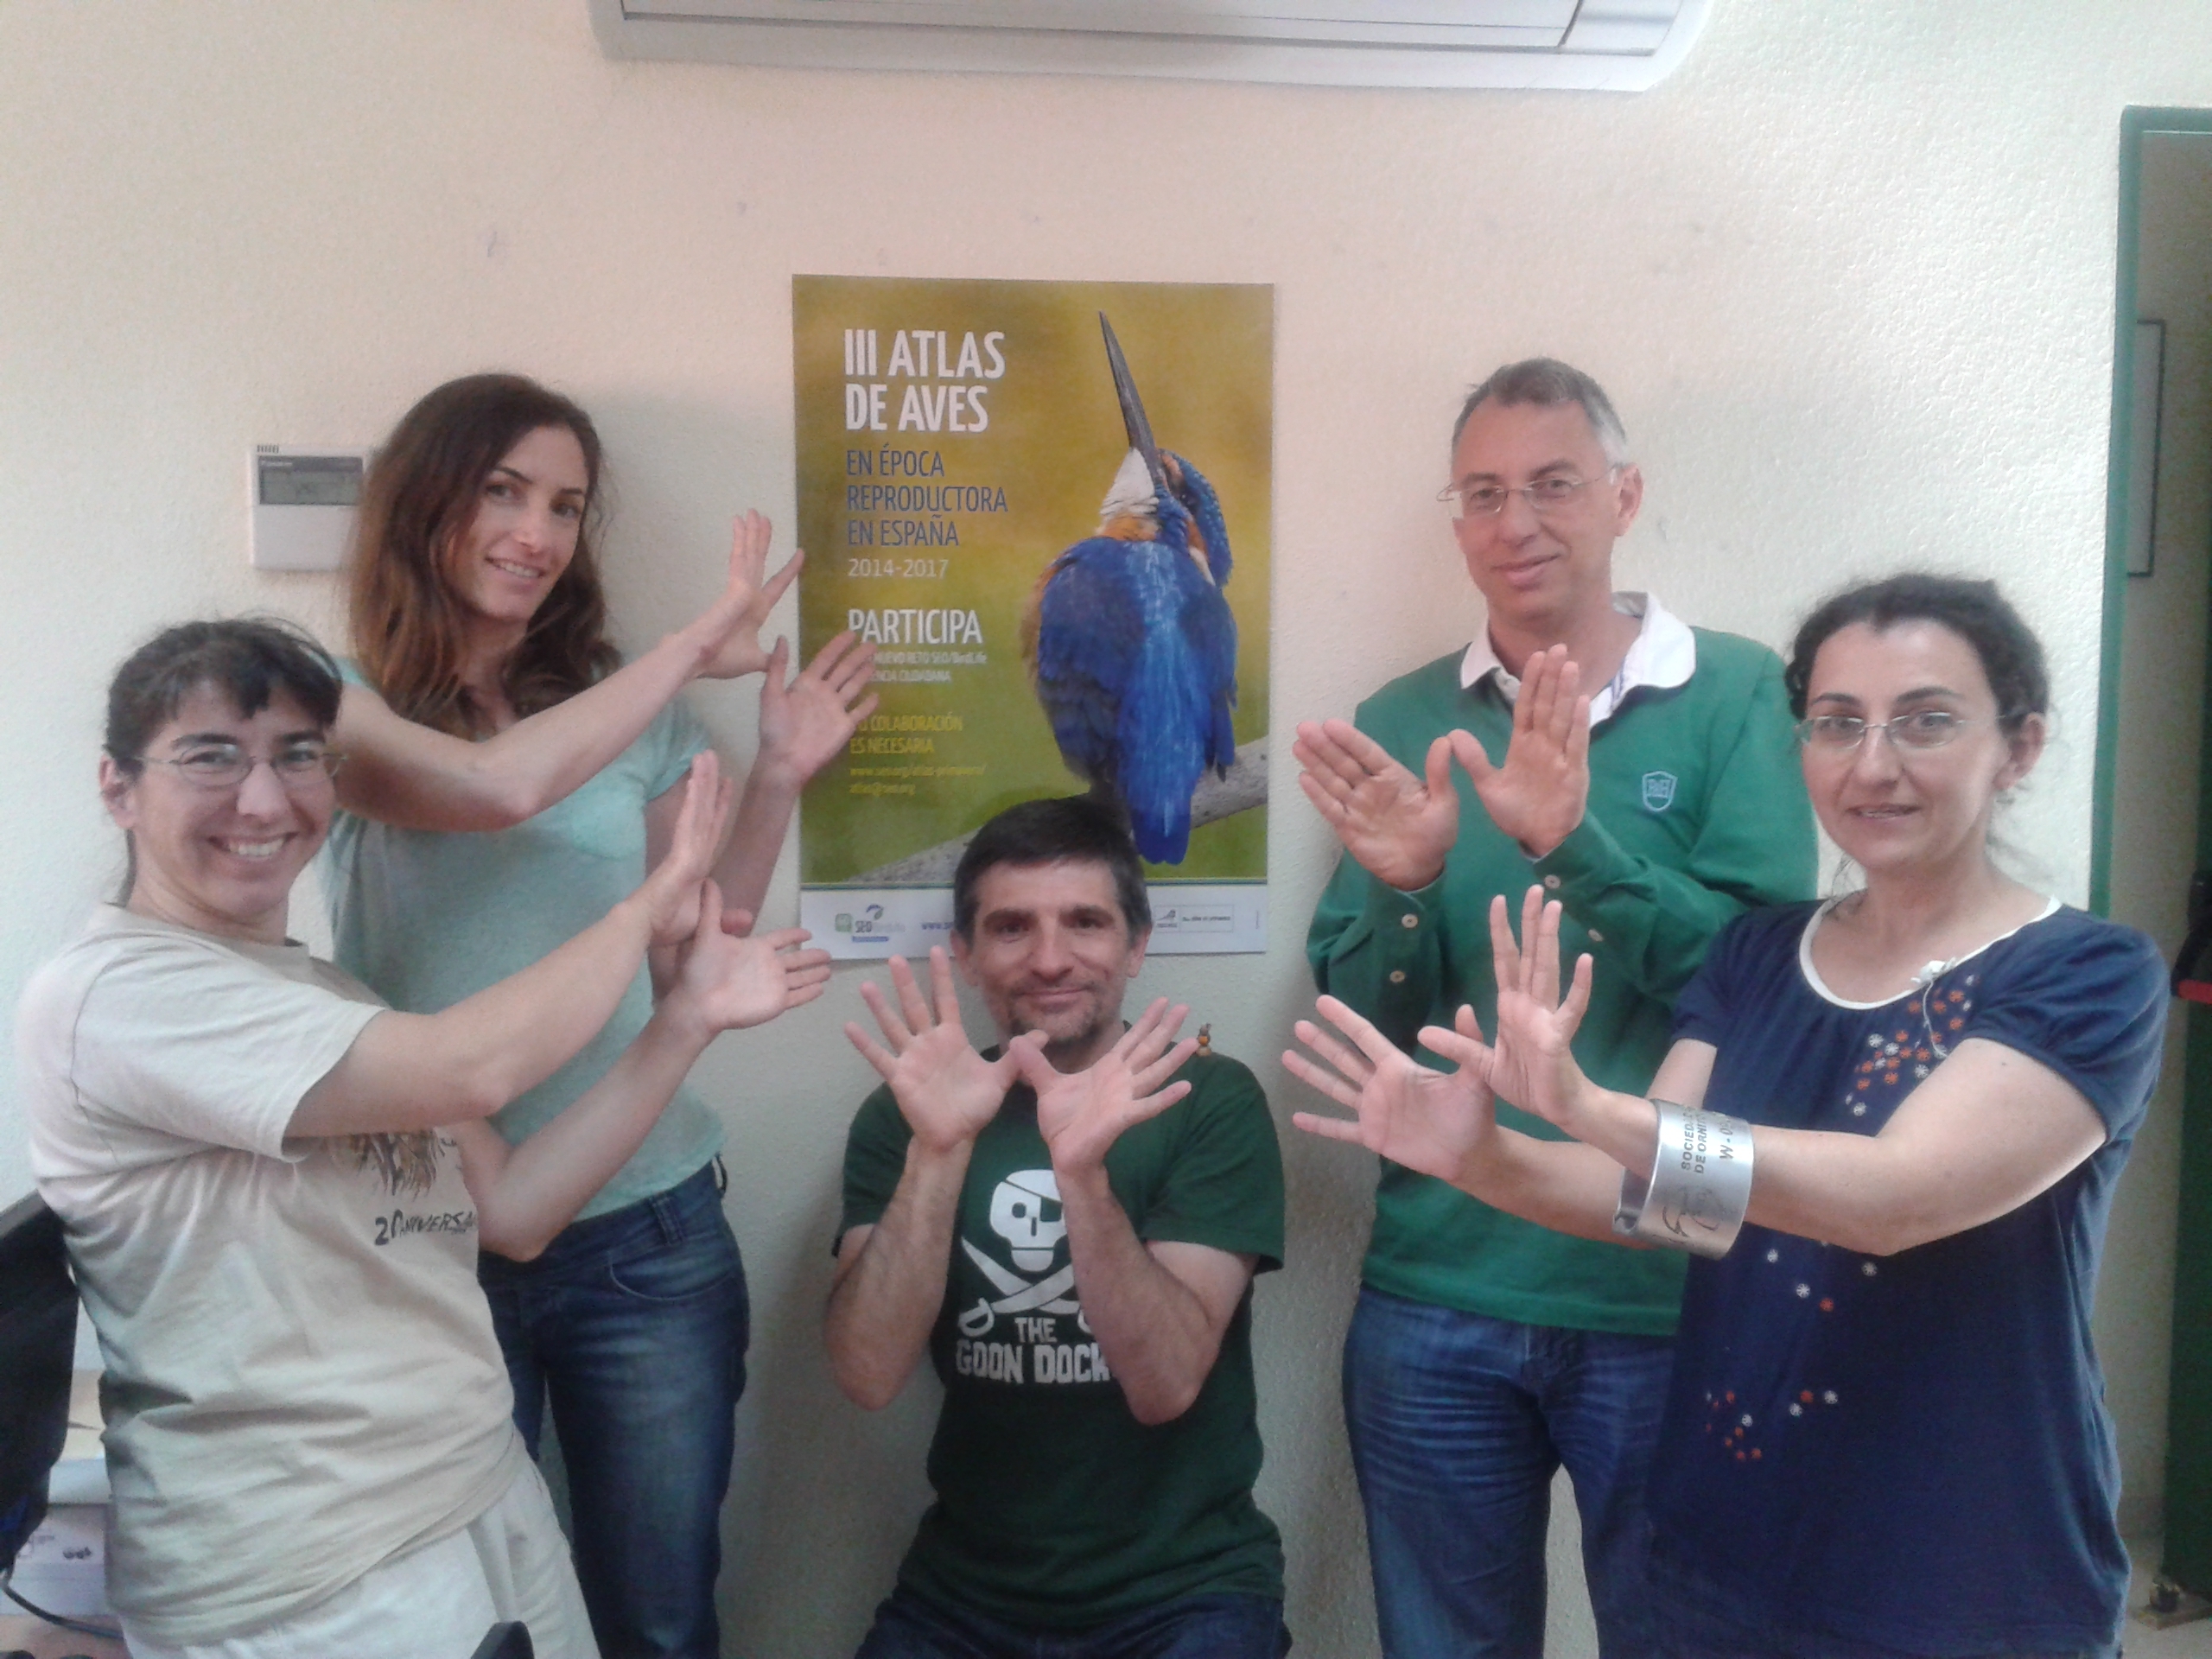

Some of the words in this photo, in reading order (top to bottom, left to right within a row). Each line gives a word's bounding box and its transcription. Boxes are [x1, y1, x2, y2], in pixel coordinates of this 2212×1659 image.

[844, 328, 877, 376] III
[888, 330, 1006, 378] ATLAS
[846, 384, 888, 430] DE
[898, 385, 988, 432] AVES
[847, 450, 873, 475] EN
[880, 442, 944, 477] ÉPOCA
[847, 485, 1008, 512] REPRODUCTORA
[848, 520, 874, 546] EN
[880, 513, 959, 547] ESPAÑA
[848, 557, 950, 578] 2014-2017
[849, 608, 983, 645] PARTICIPA
[1014, 1317, 1057, 1343] THE
[956, 1339, 1024, 1383] GOON
